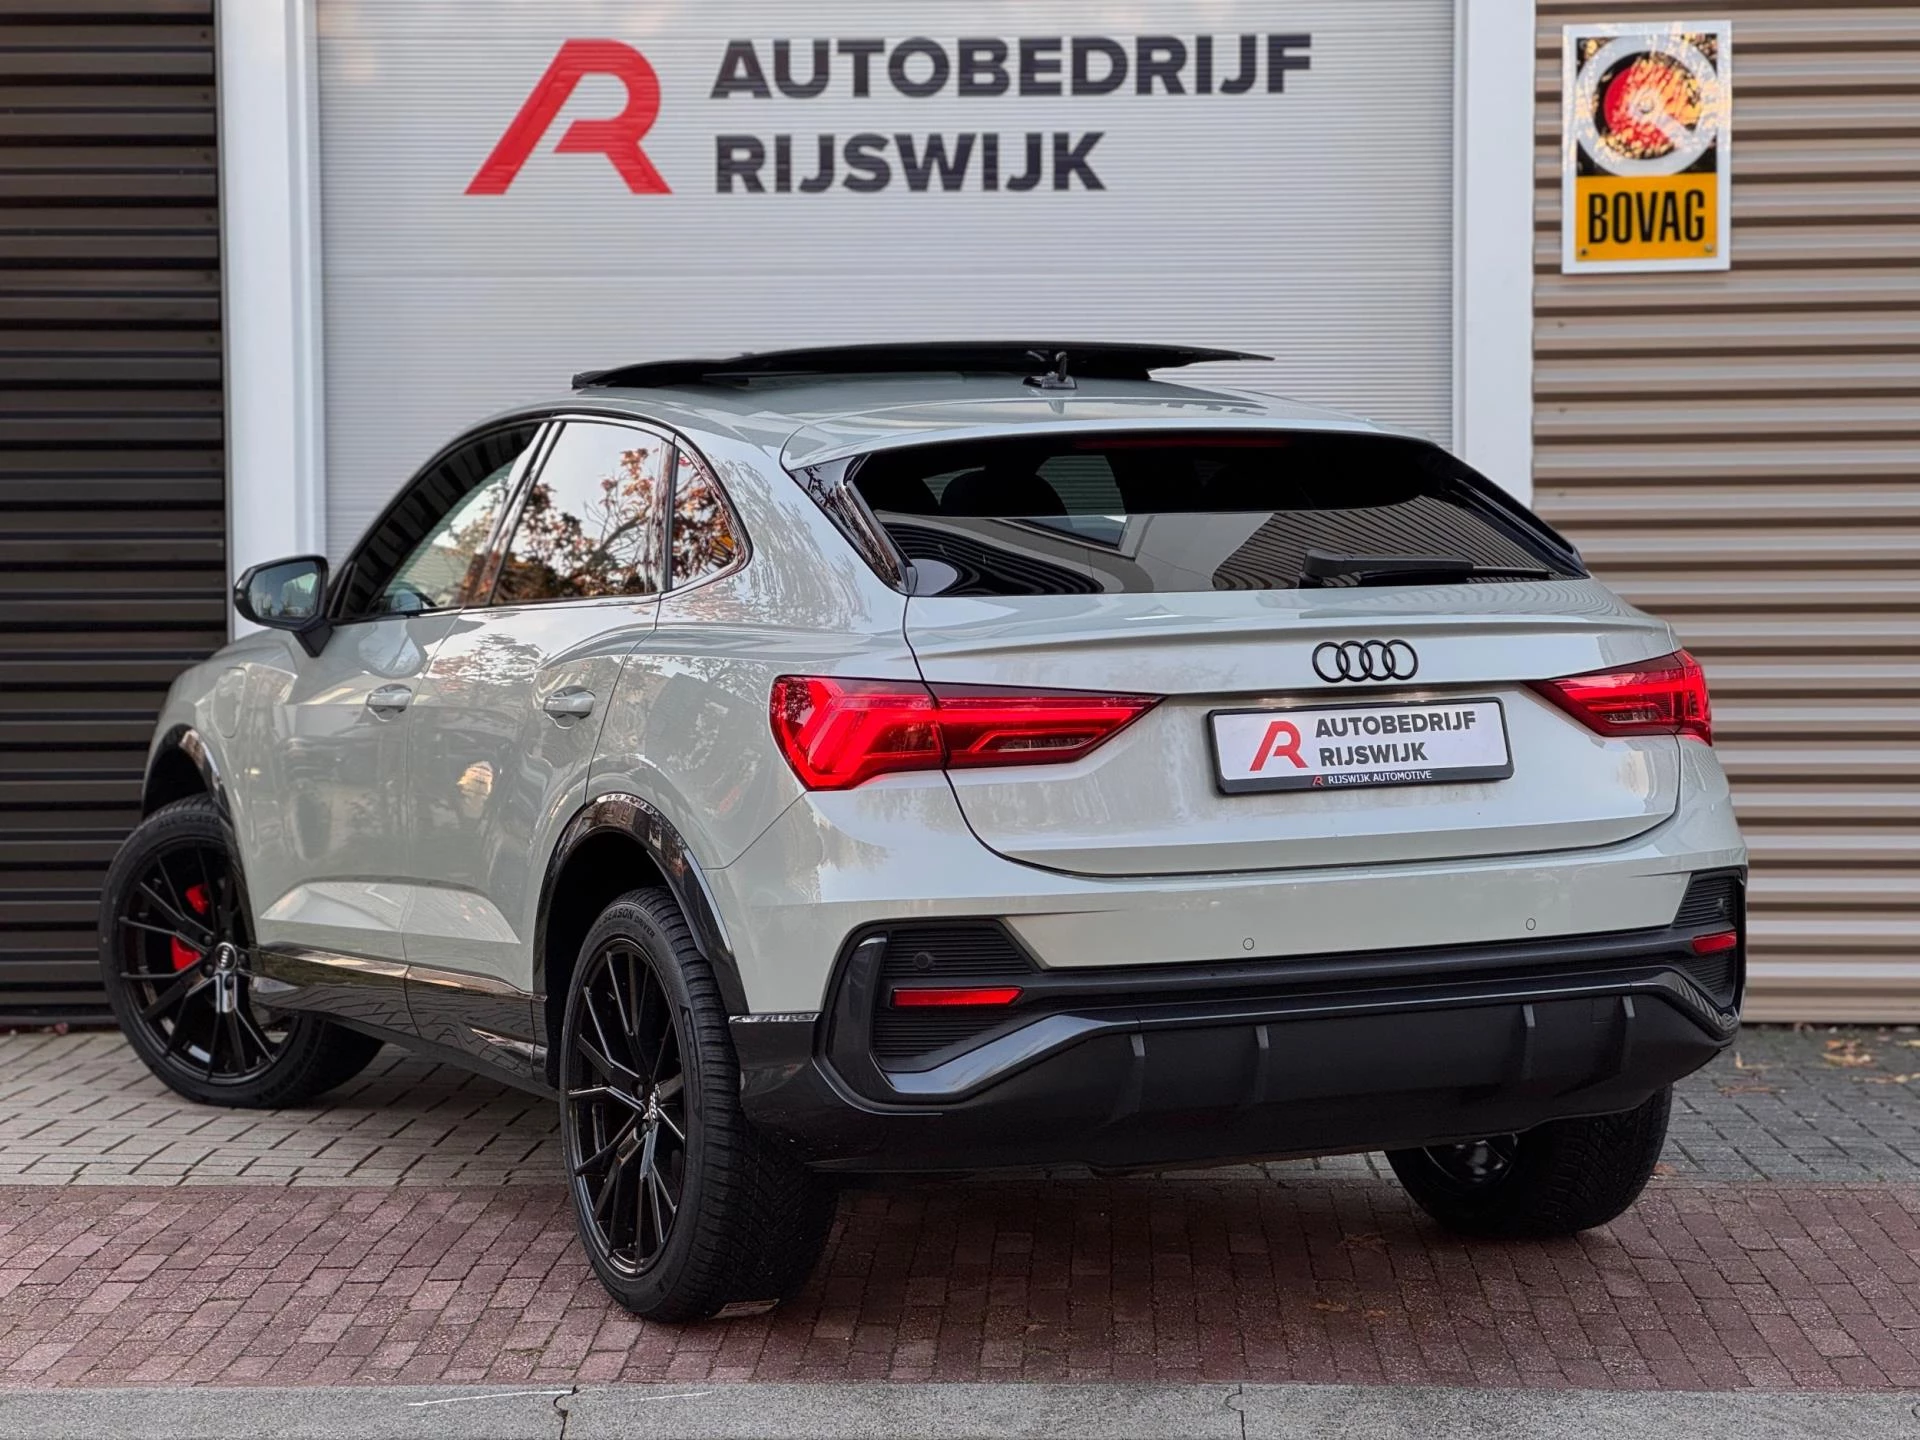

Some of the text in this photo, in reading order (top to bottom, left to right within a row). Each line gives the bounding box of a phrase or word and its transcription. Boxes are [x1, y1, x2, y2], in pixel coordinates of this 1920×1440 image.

[710, 33, 1312, 98] AUTOBEDRIJF
[715, 131, 1107, 194] RIJSWIJK
[1588, 189, 1705, 244] BOVAG
[1315, 711, 1476, 738] AUTOBEDRIJF
[1319, 742, 1429, 767] RIJSWIJK
[1328, 773, 1370, 785] RIJSWIJK
[1372, 770, 1433, 781] AUTOMOTIVE
